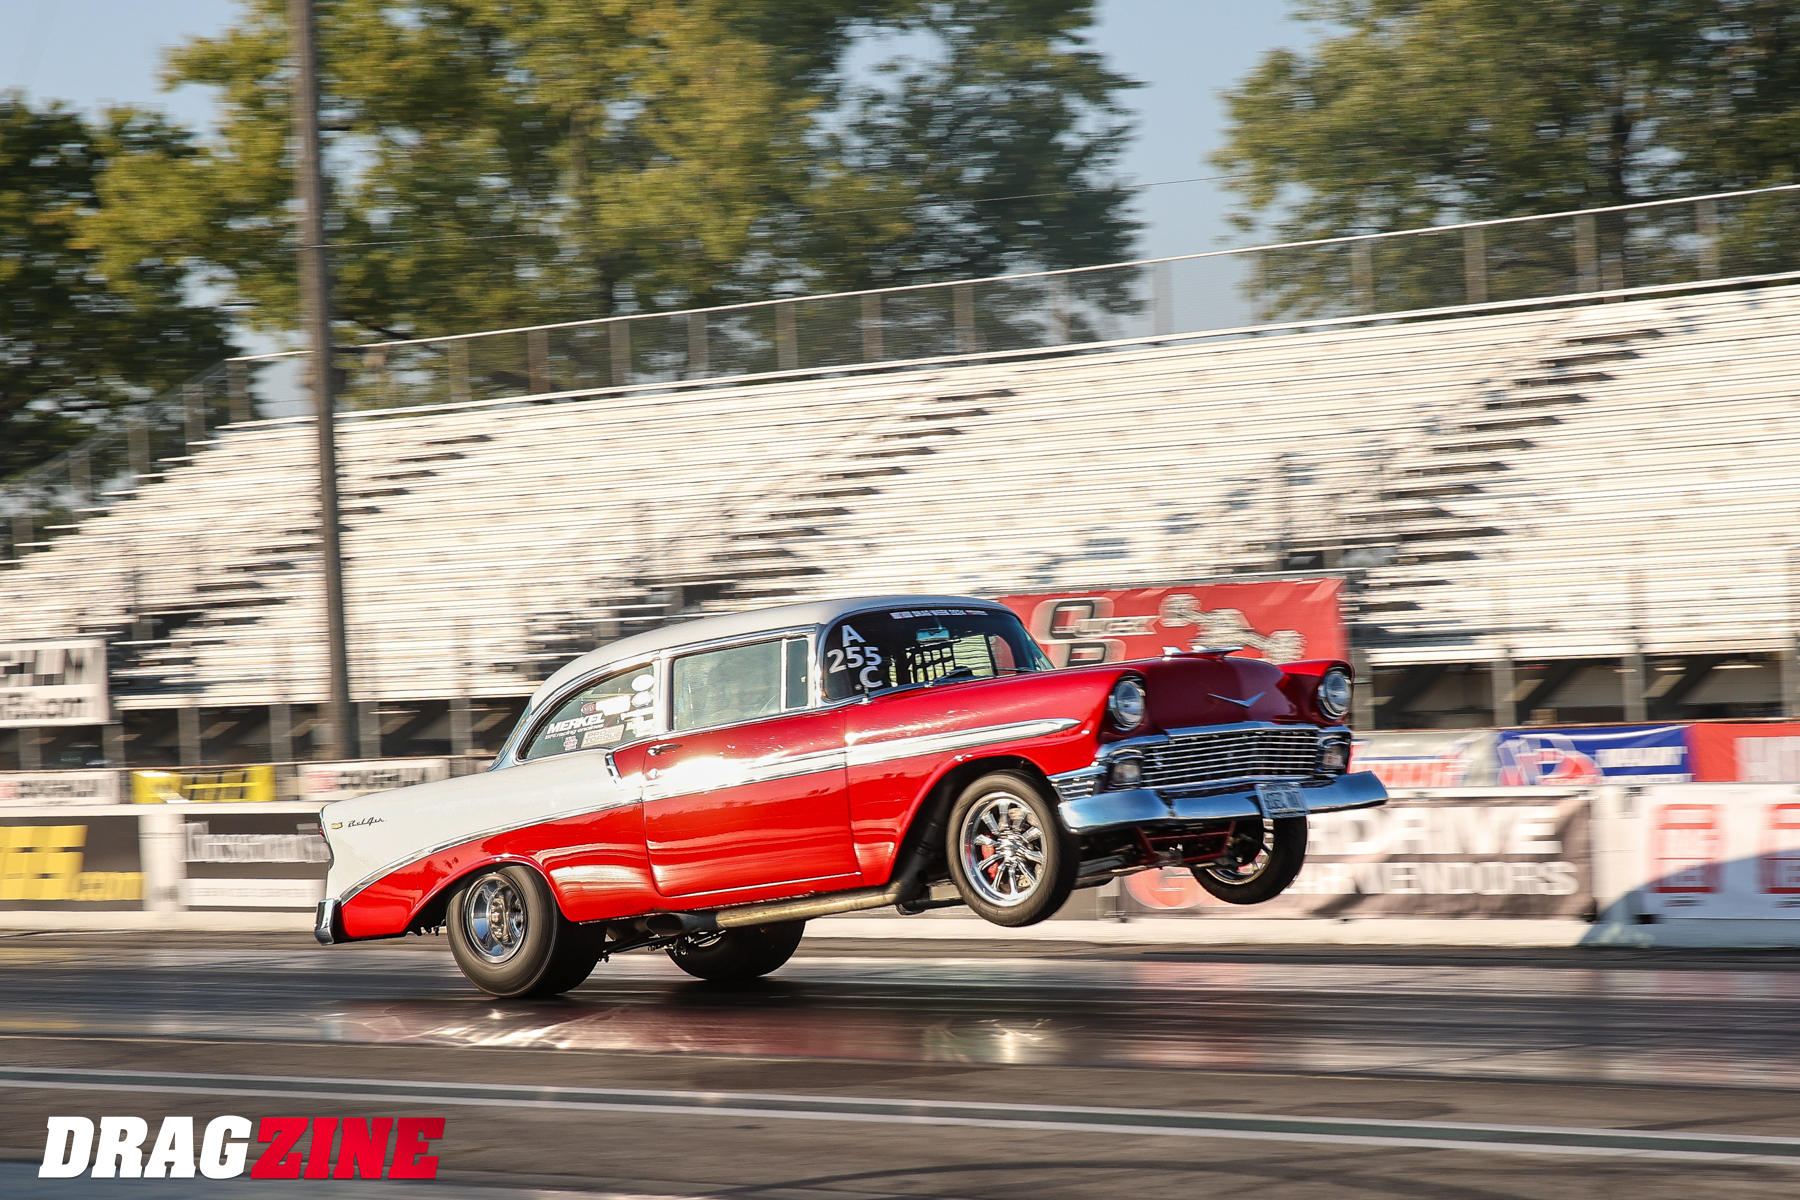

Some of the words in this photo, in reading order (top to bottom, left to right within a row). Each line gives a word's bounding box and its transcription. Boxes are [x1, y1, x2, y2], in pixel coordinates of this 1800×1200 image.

[841, 624, 866, 647] A
[827, 646, 883, 674] 255
[859, 665, 883, 688] C
[546, 712, 605, 735] MERKEL
